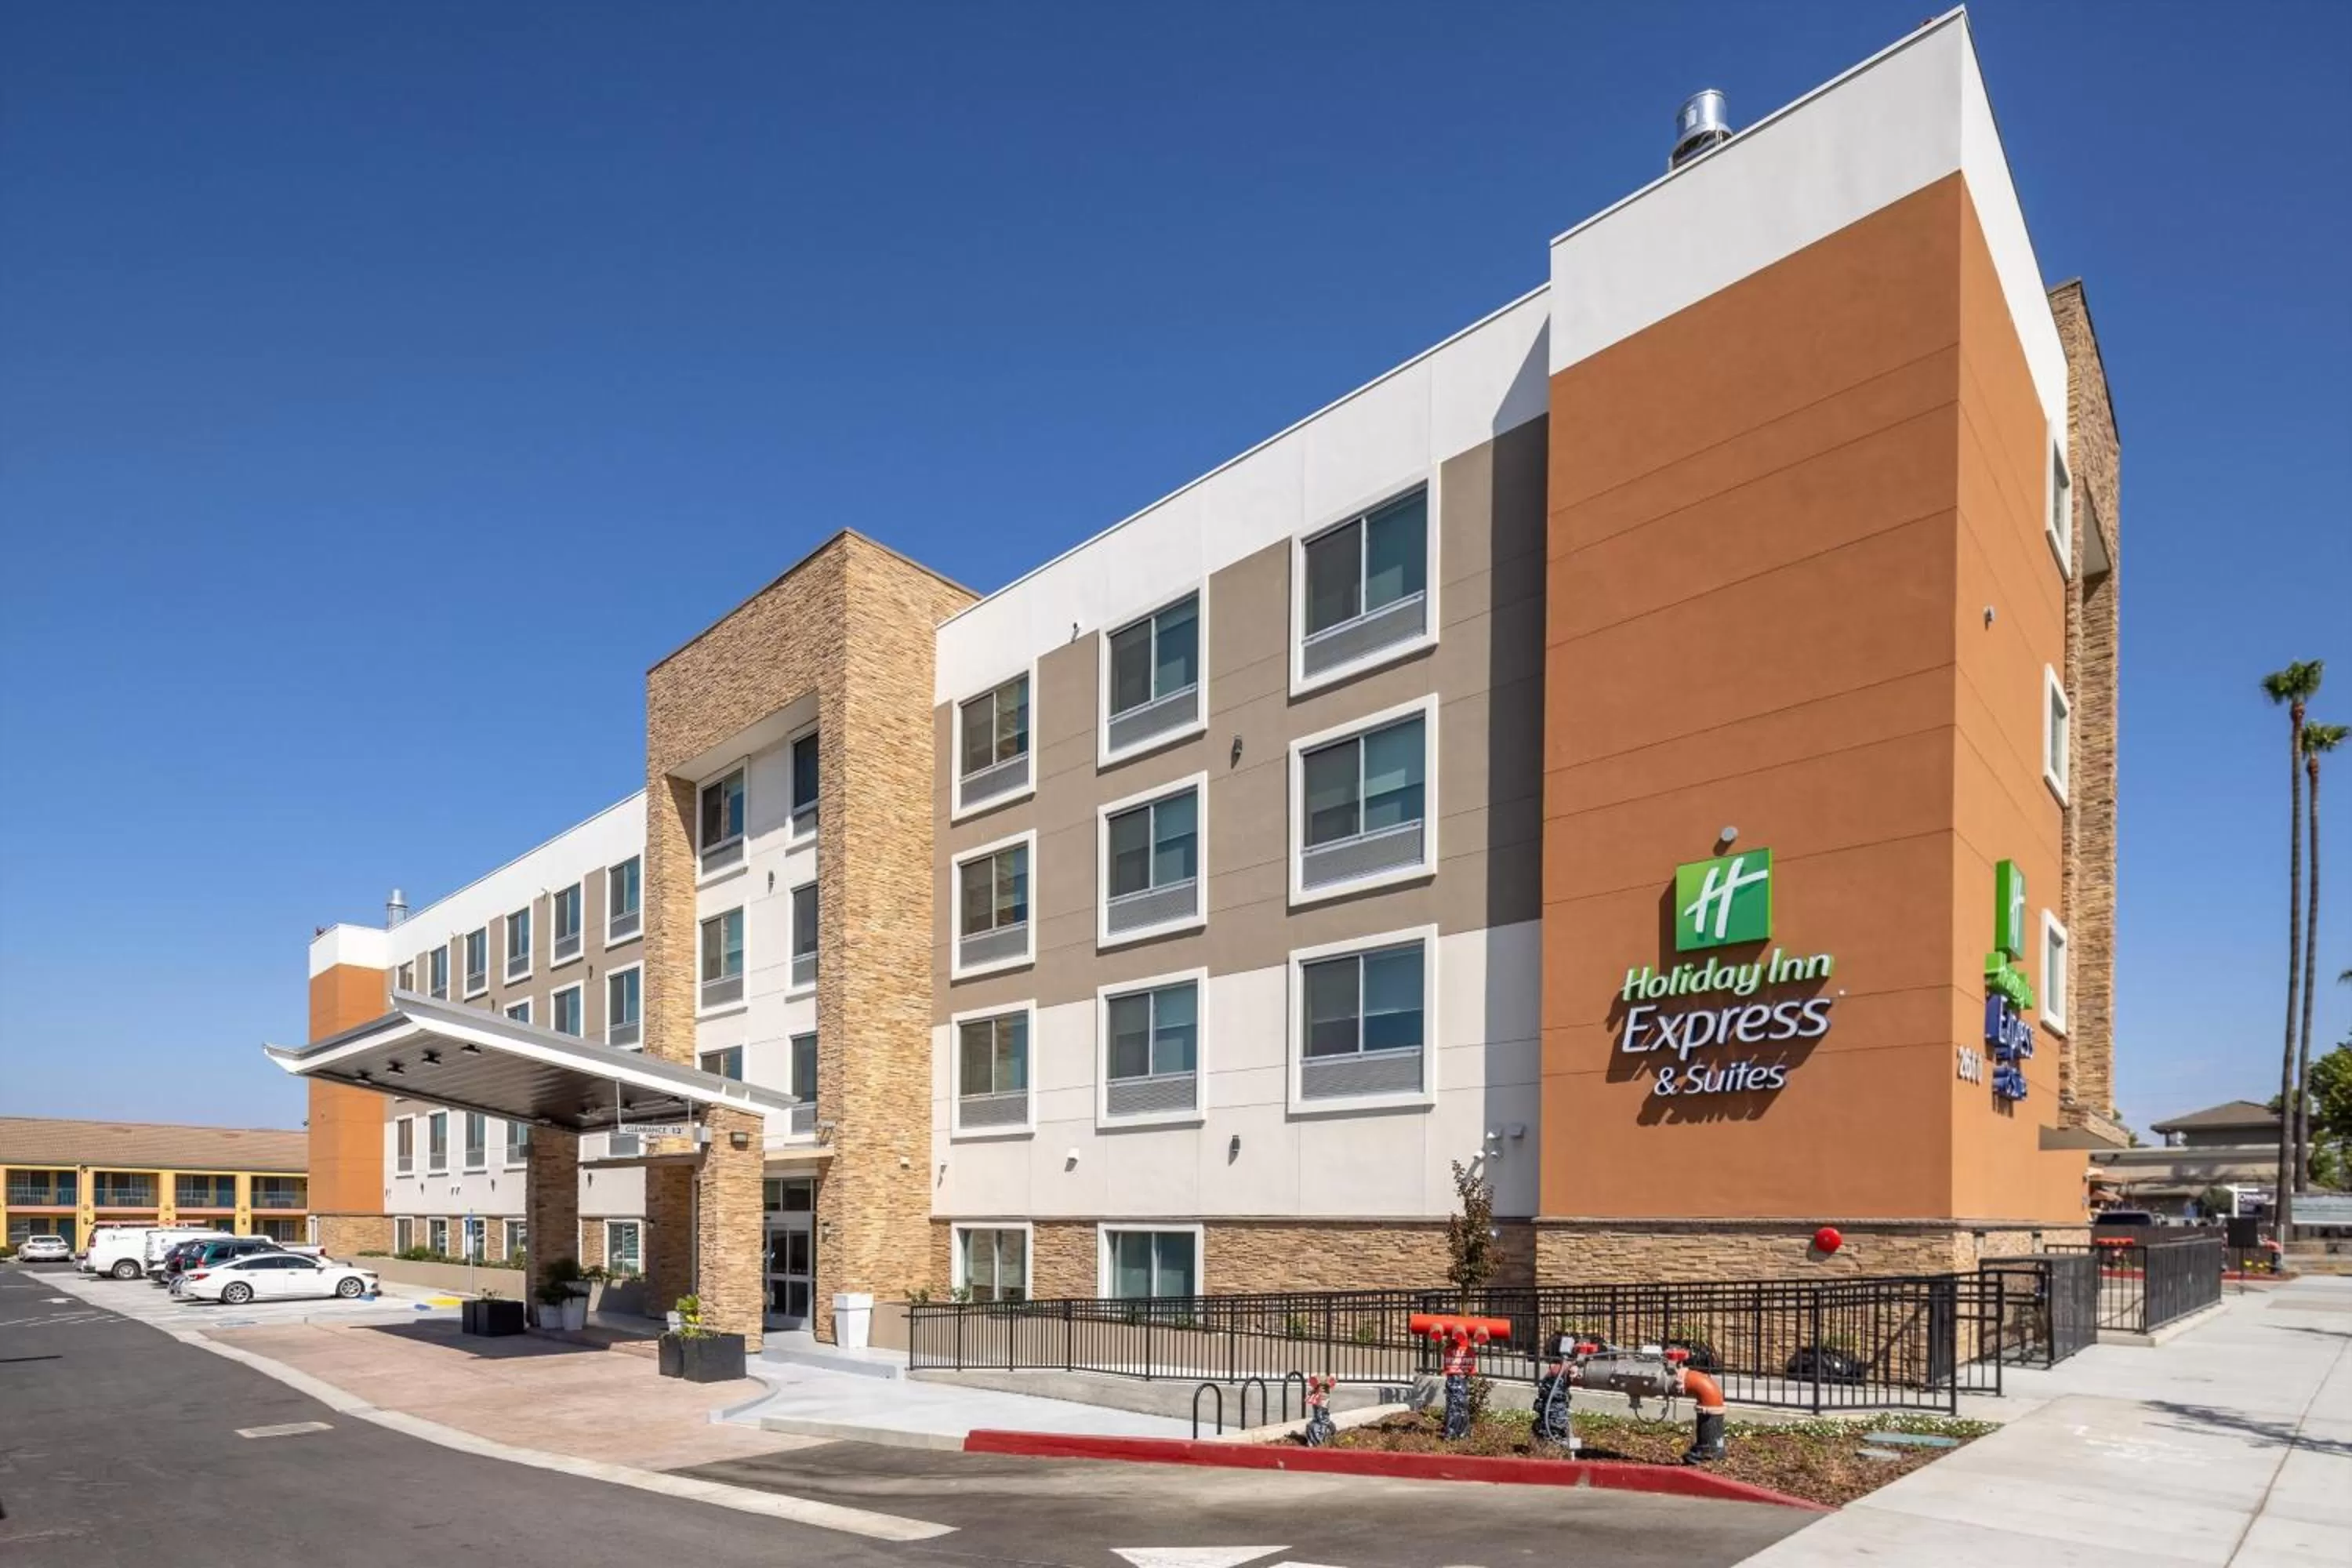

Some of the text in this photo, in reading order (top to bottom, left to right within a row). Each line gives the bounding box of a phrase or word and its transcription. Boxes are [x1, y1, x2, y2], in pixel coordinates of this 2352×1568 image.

[1621, 948, 1835, 1001] Holiday Inn
[1621, 997, 1833, 1061] Express
[1653, 1061, 1787, 1096] & Suites
